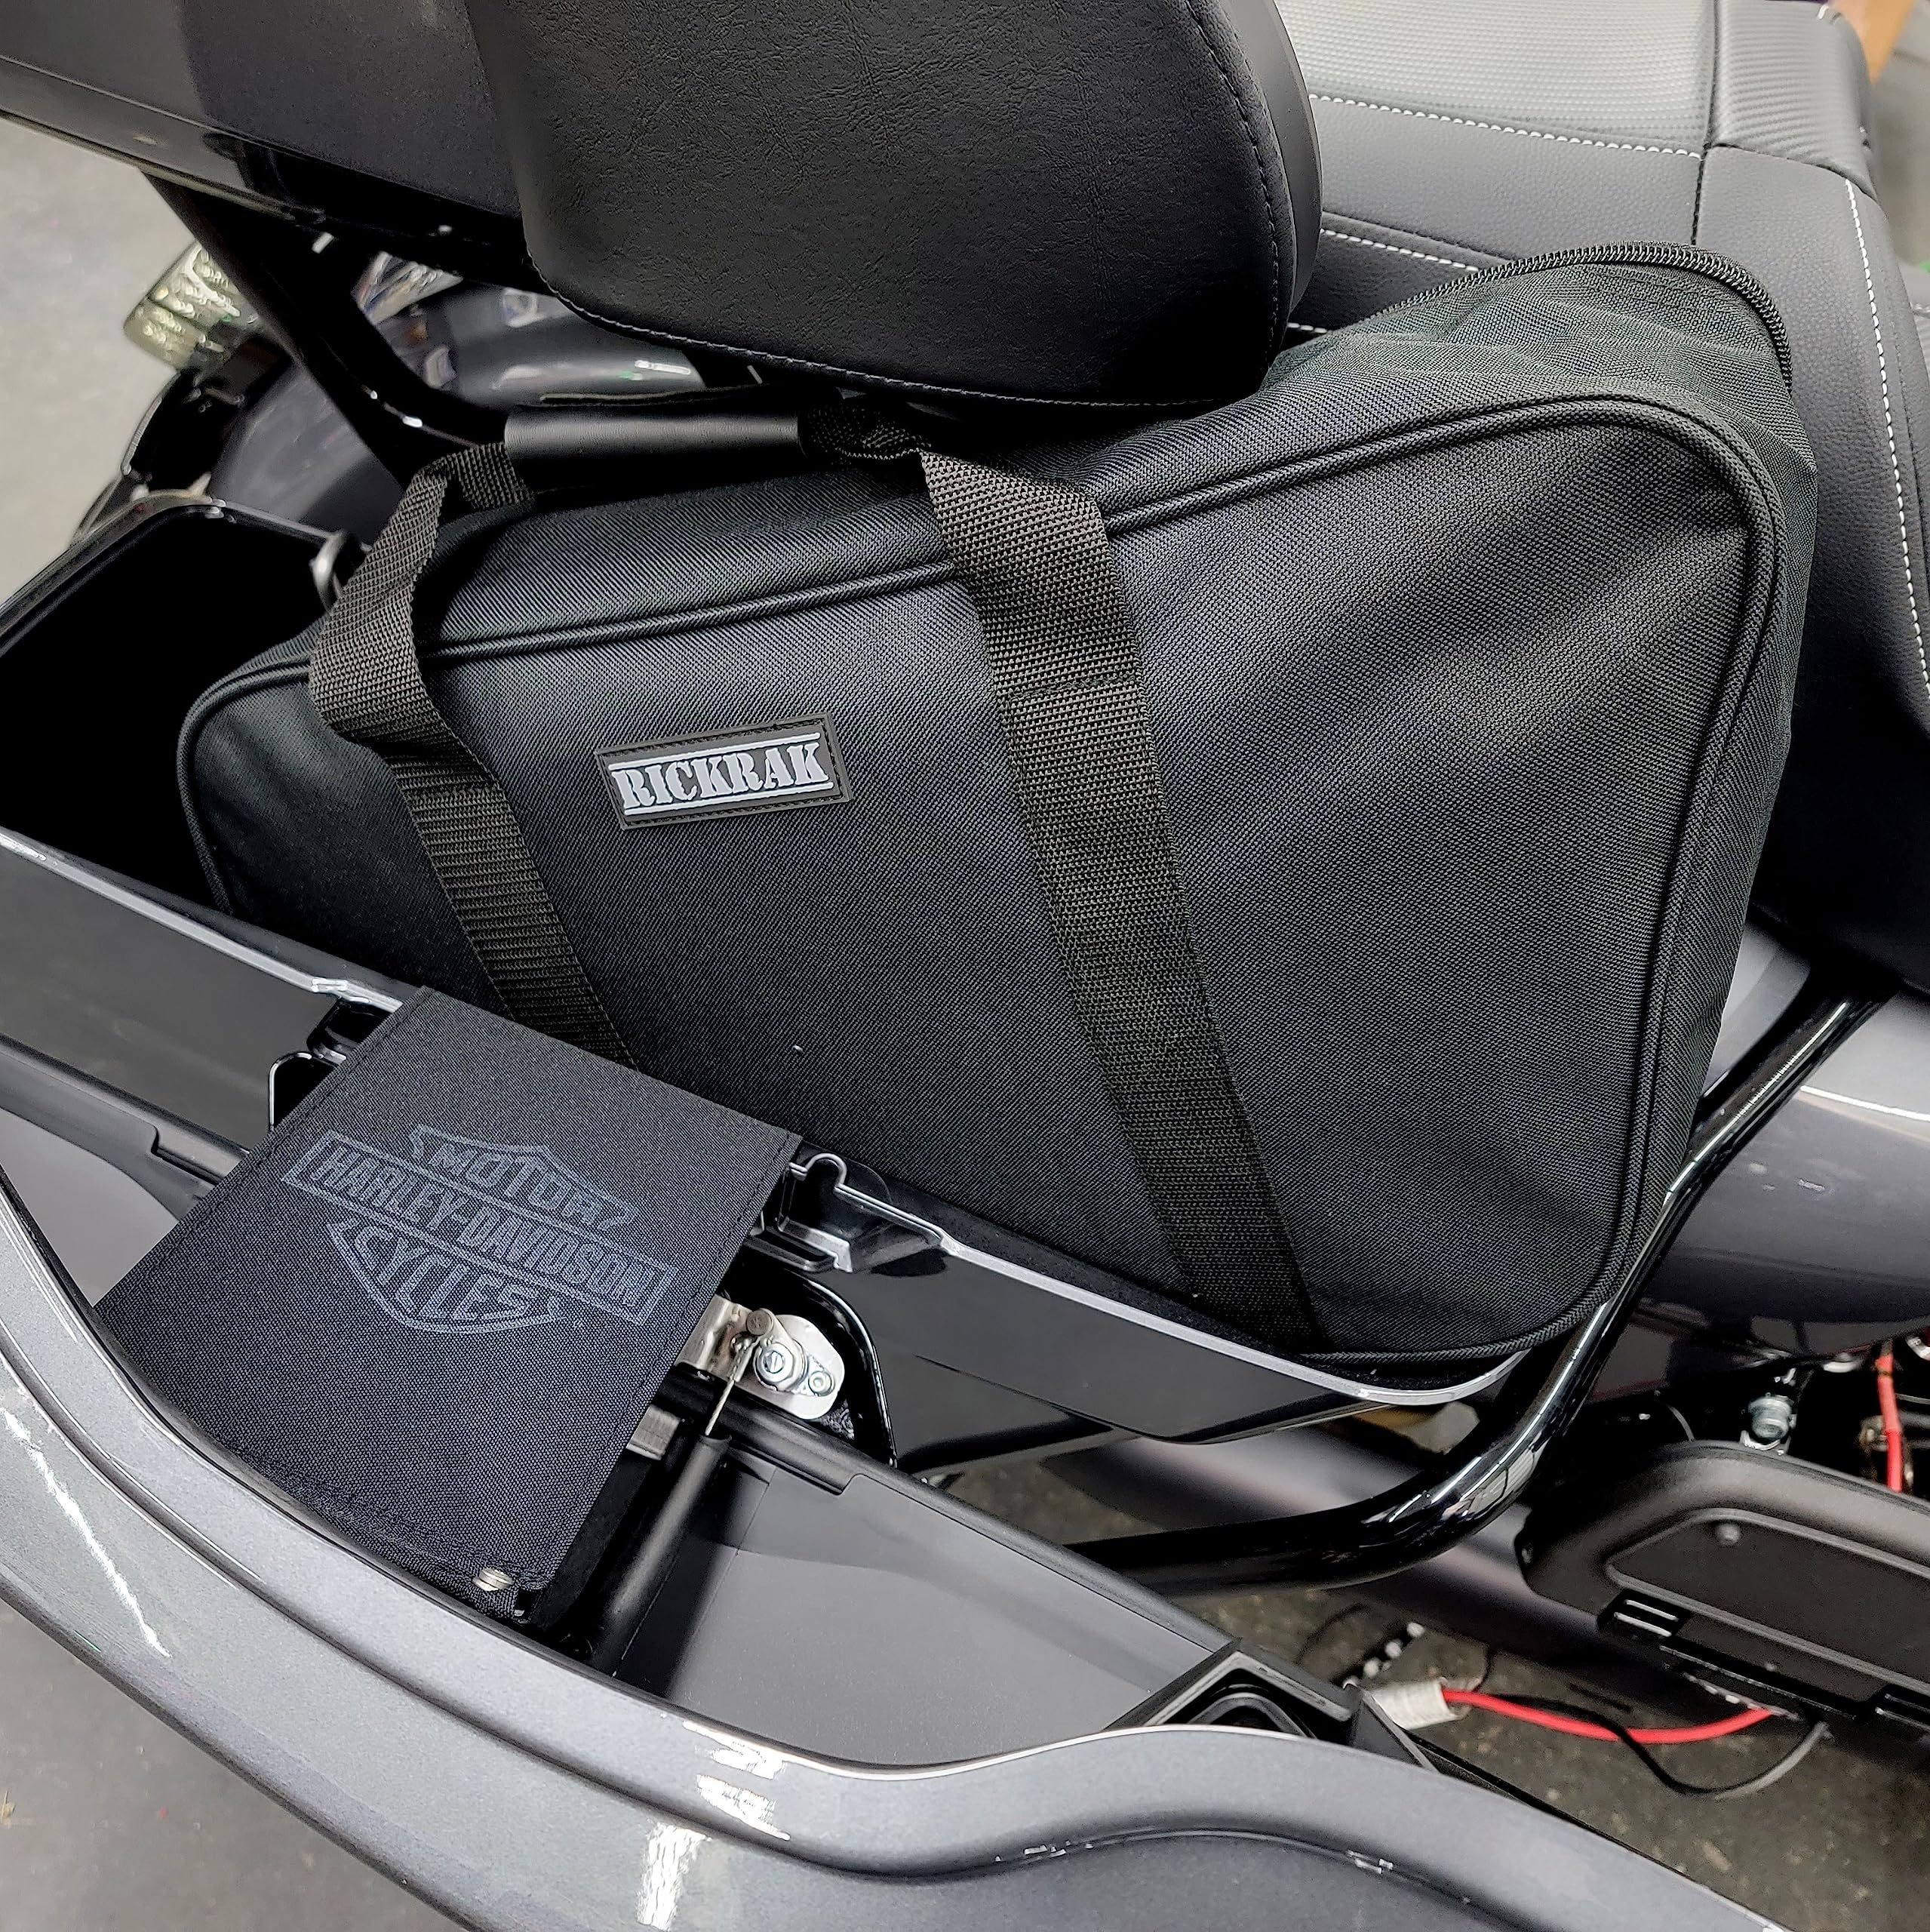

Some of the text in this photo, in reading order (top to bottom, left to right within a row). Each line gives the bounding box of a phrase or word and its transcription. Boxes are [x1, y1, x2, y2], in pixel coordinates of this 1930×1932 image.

[612, 742, 829, 808] RICKRAK
[309, 1146, 655, 1306] HARLEY-DAVIDSON
[428, 1143, 603, 1225] MOTOR
[355, 1225, 540, 1321] CYCLES
